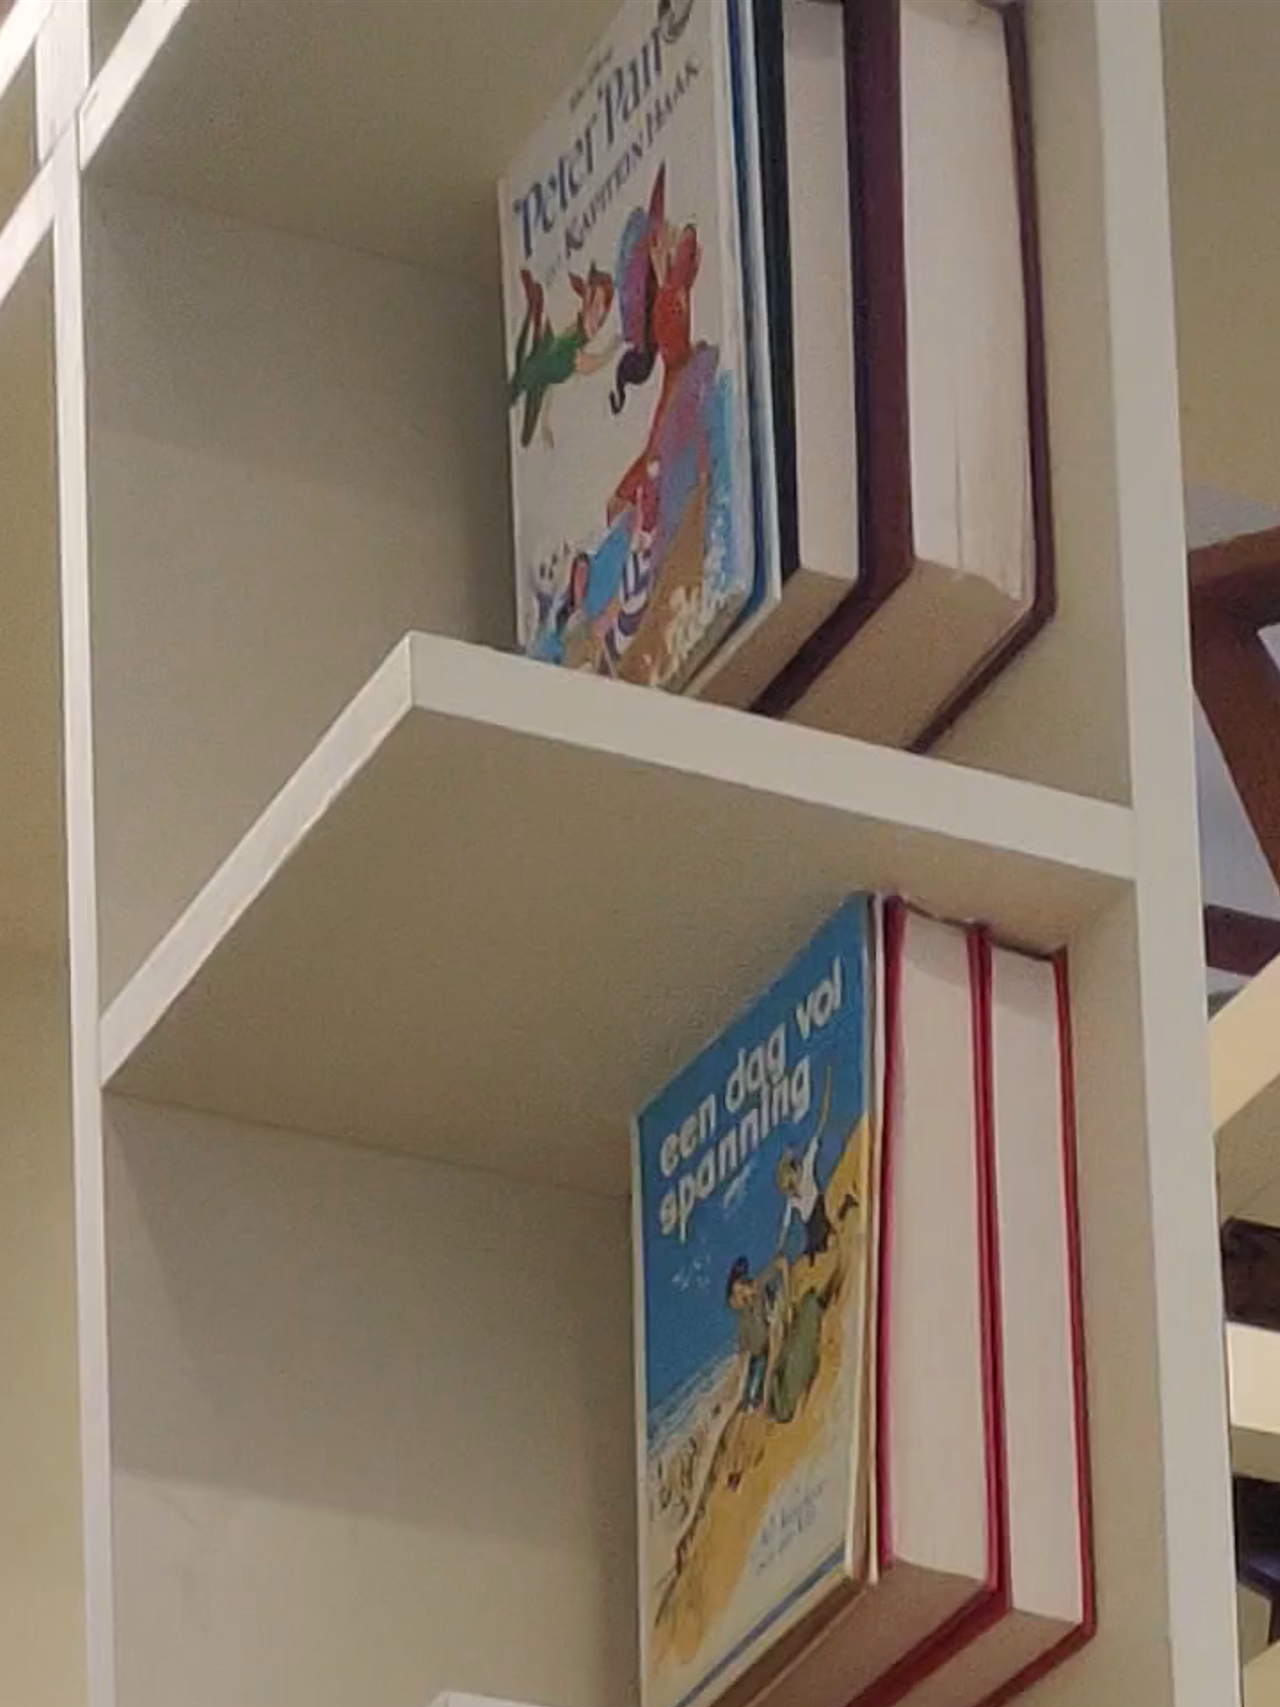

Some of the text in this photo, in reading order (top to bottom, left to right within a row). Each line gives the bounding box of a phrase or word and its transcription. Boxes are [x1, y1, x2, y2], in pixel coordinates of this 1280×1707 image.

[659, 954, 842, 1178] een dag vol
[659, 1054, 812, 1243] spanning
